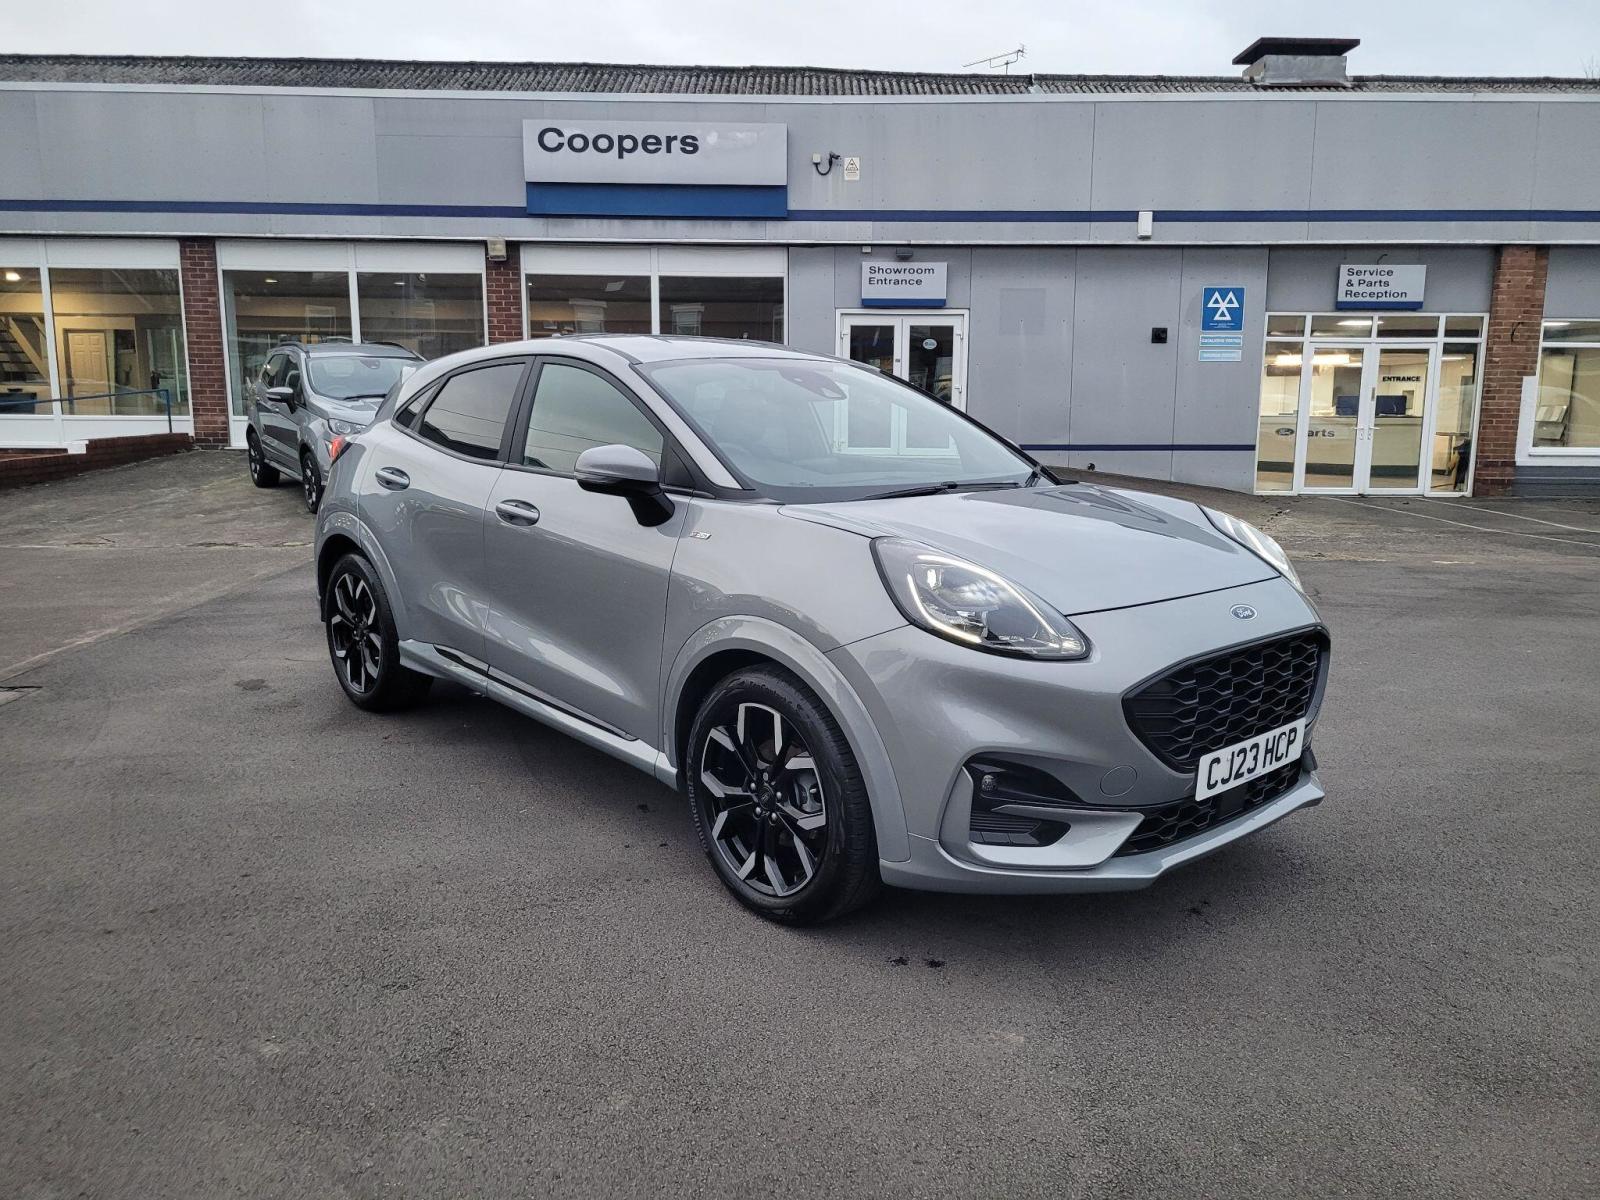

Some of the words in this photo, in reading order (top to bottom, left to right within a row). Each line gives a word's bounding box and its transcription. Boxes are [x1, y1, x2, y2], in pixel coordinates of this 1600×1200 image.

[537, 127, 700, 159] Coopers
[868, 265, 935, 275] Showroom
[1346, 267, 1394, 277] Service
[868, 277, 923, 286] Entrance
[1346, 279, 1354, 287] &
[1357, 278, 1390, 287] Parts
[1344, 289, 1408, 299] Reception
[1308, 428, 1336, 438] arts
[1206, 742, 1260, 791] CJ23
[1262, 726, 1298, 769] HCP
